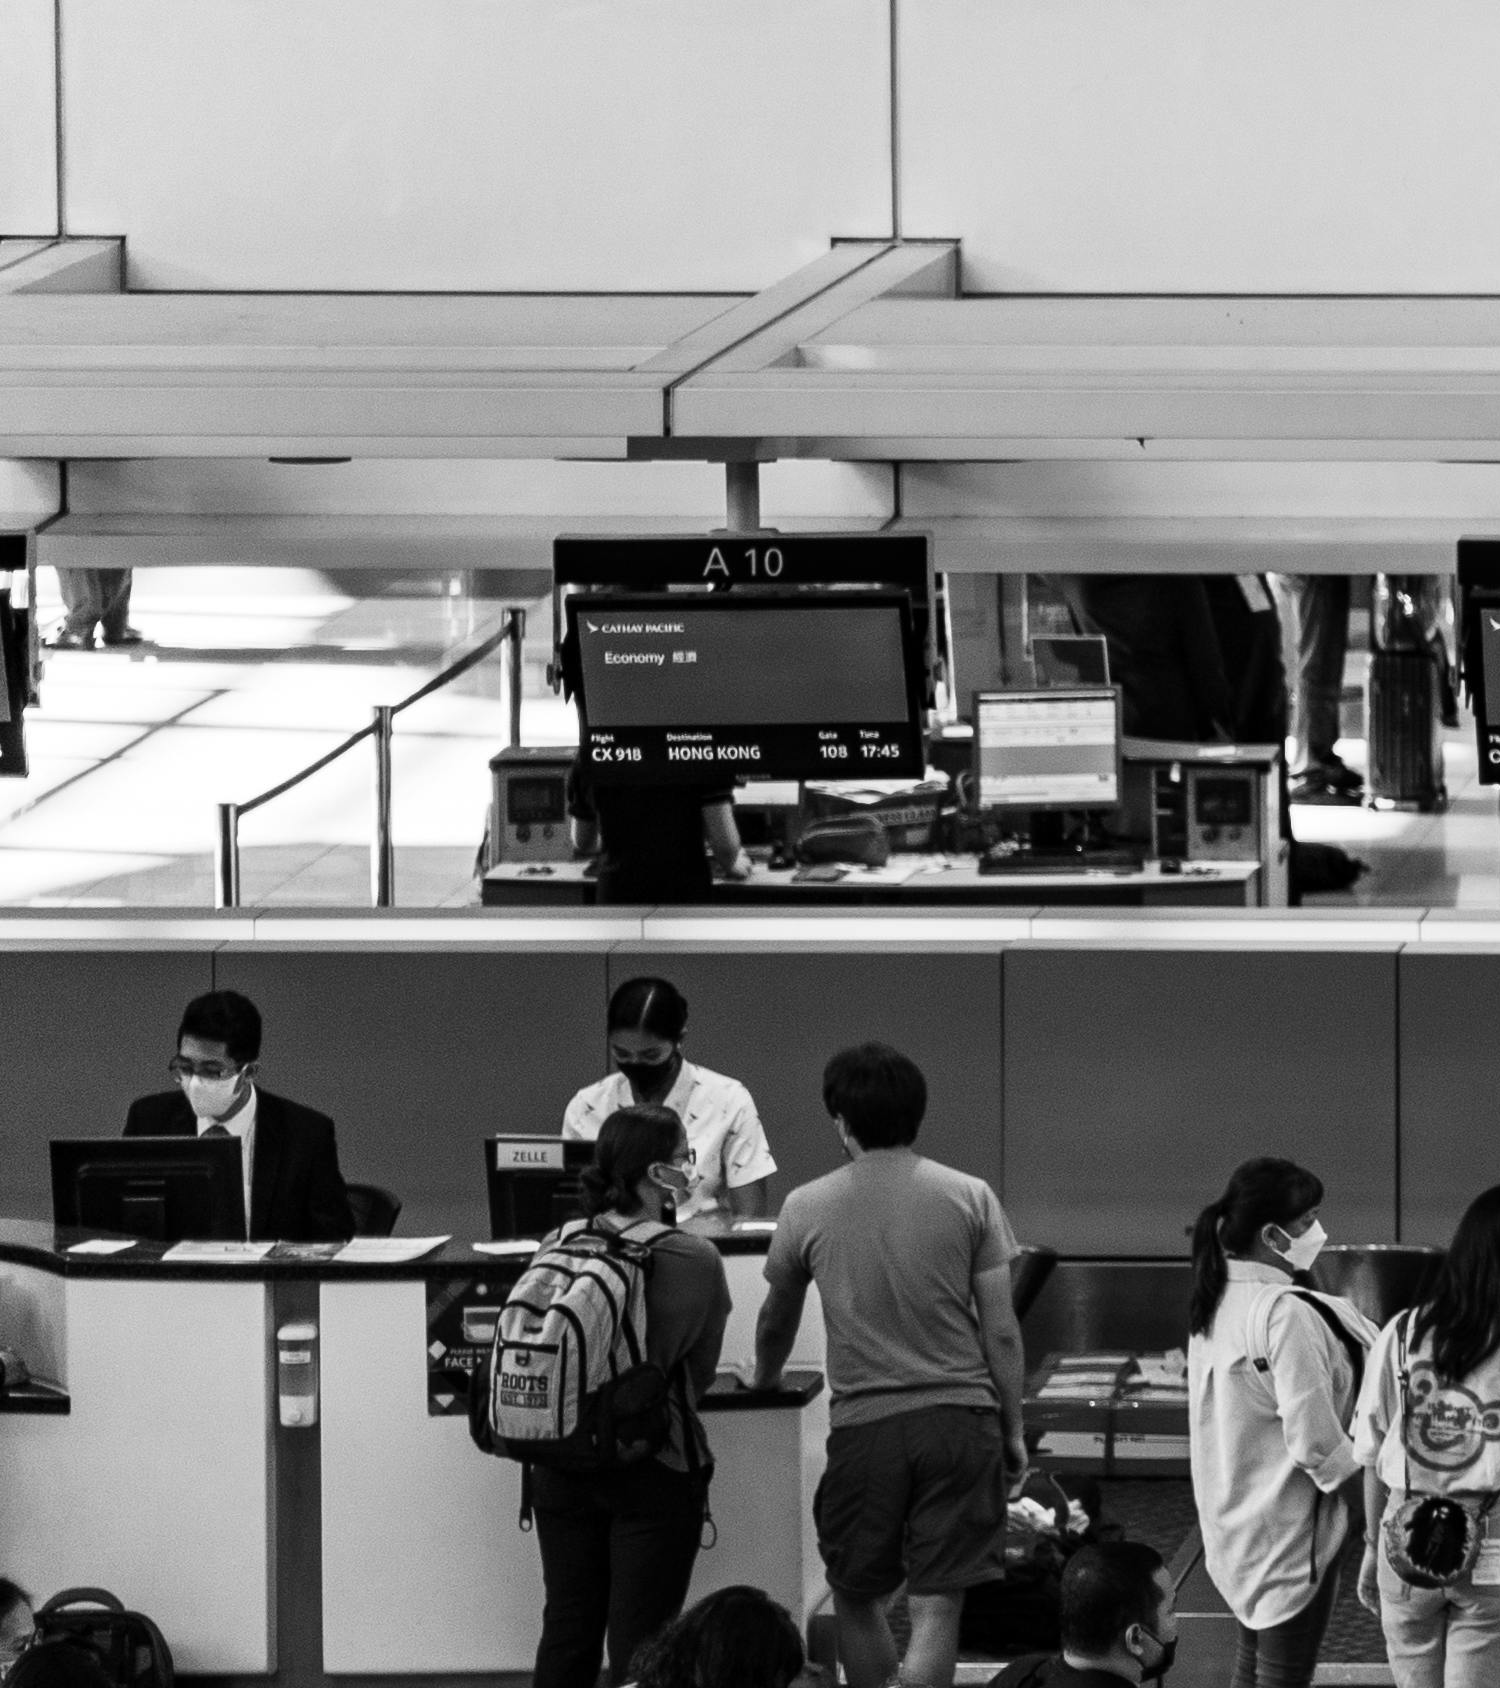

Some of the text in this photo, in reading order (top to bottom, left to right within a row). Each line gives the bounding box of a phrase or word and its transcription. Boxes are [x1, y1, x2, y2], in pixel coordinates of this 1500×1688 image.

[702, 547, 783, 577] A 10
[601, 622, 685, 634] CATHAY PACIFIC
[604, 650, 665, 665] Economy
[591, 746, 642, 762] CX 918
[668, 745, 761, 761] HONG KONG
[820, 744, 848, 759] 108
[860, 743, 900, 759] 17:45
[511, 1151, 548, 1163] ZELLE
[445, 1357, 474, 1369] FACE
[501, 1372, 548, 1394] ROOTS
